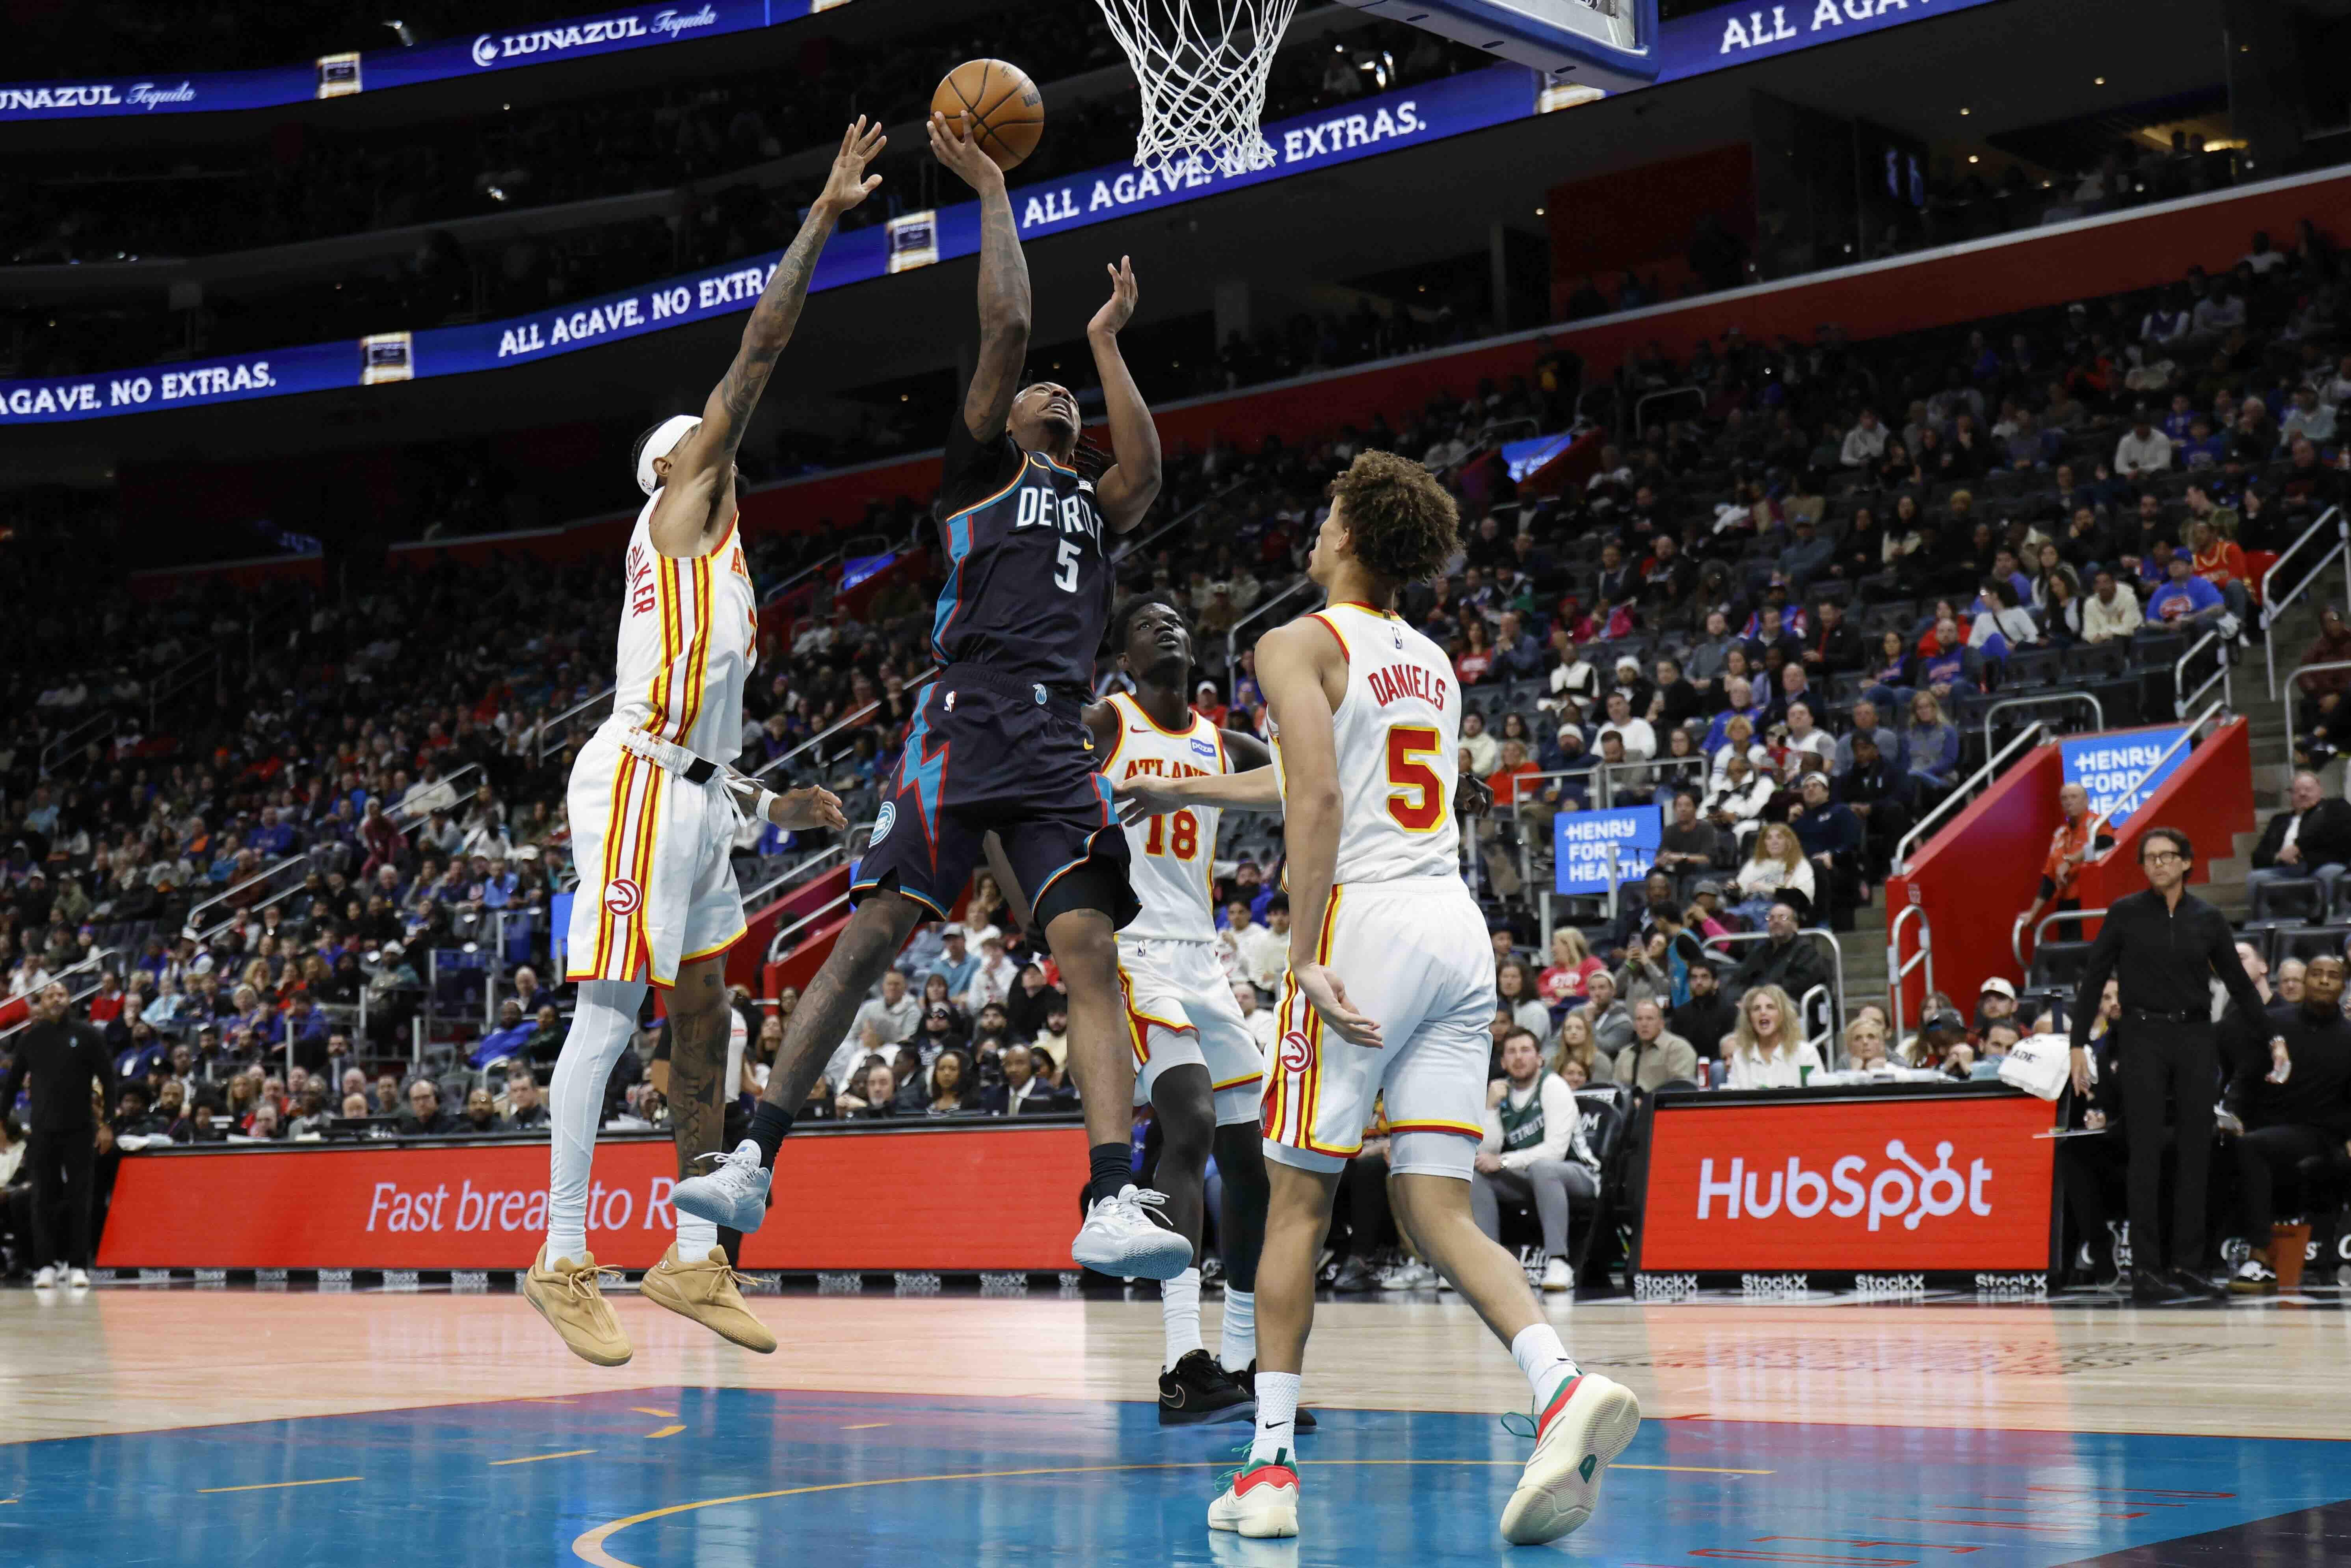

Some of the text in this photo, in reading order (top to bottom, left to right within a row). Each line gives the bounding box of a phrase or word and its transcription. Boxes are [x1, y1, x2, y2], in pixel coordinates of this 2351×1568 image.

[501, 4, 719, 58] LUNAZUL Tequila
[1719, 6, 1797, 55] ALL
[126, 81, 196, 110] Tequila
[1022, 189, 1080, 229] ALL
[1284, 101, 1427, 163] EXTRAS.
[497, 323, 545, 357] ALL
[551, 297, 644, 346] AGAVE.
[652, 287, 691, 320] NO
[111, 378, 153, 406] NO
[162, 362, 277, 401] EXTRAS.
[1054, 537, 1082, 593] 5
[1367, 664, 1446, 711] DANIELS
[1192, 742, 1213, 753] paze
[2075, 744, 2161, 772] HENRY
[1386, 725, 1447, 833] 5
[1145, 809, 1198, 861] 18
[1564, 818, 1636, 841] HENRY
[366, 1177, 676, 1232] Fast brea to R
[1697, 1139, 1992, 1232] HubSpot
[1634, 1274, 1698, 1290] StockX
[1742, 1274, 1807, 1290] StockX
[1855, 1274, 1924, 1291] StockX
